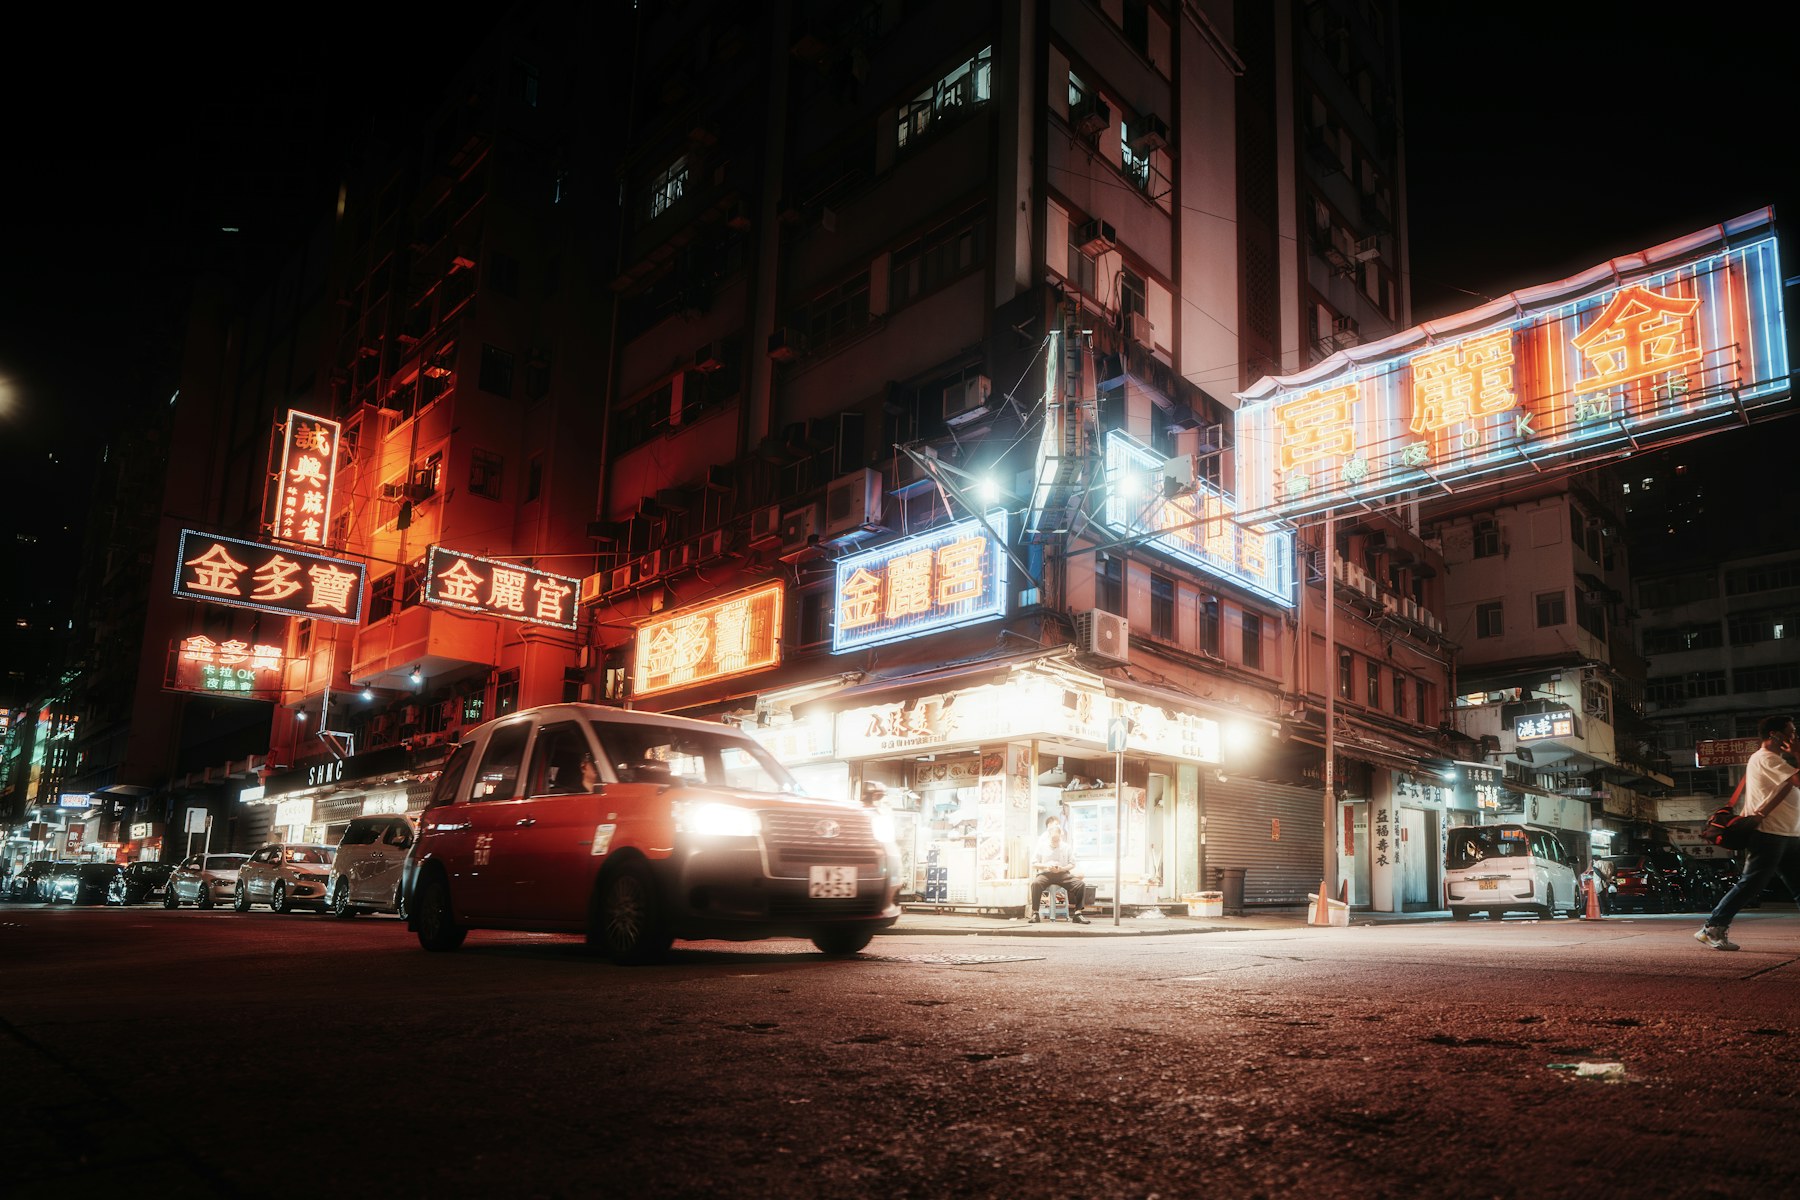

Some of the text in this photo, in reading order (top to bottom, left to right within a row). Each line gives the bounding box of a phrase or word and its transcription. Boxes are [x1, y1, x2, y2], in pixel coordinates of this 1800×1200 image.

[184, 543, 358, 614] 金多寶
[184, 635, 283, 671] 金多寶
[647, 606, 747, 678] 金多寶
[207, 677, 252, 694] 夜總會
[1700, 741, 1760, 755] 福年地產
[1712, 756, 1735, 764] 2781
[1376, 809, 1389, 867] 益福壽衣
